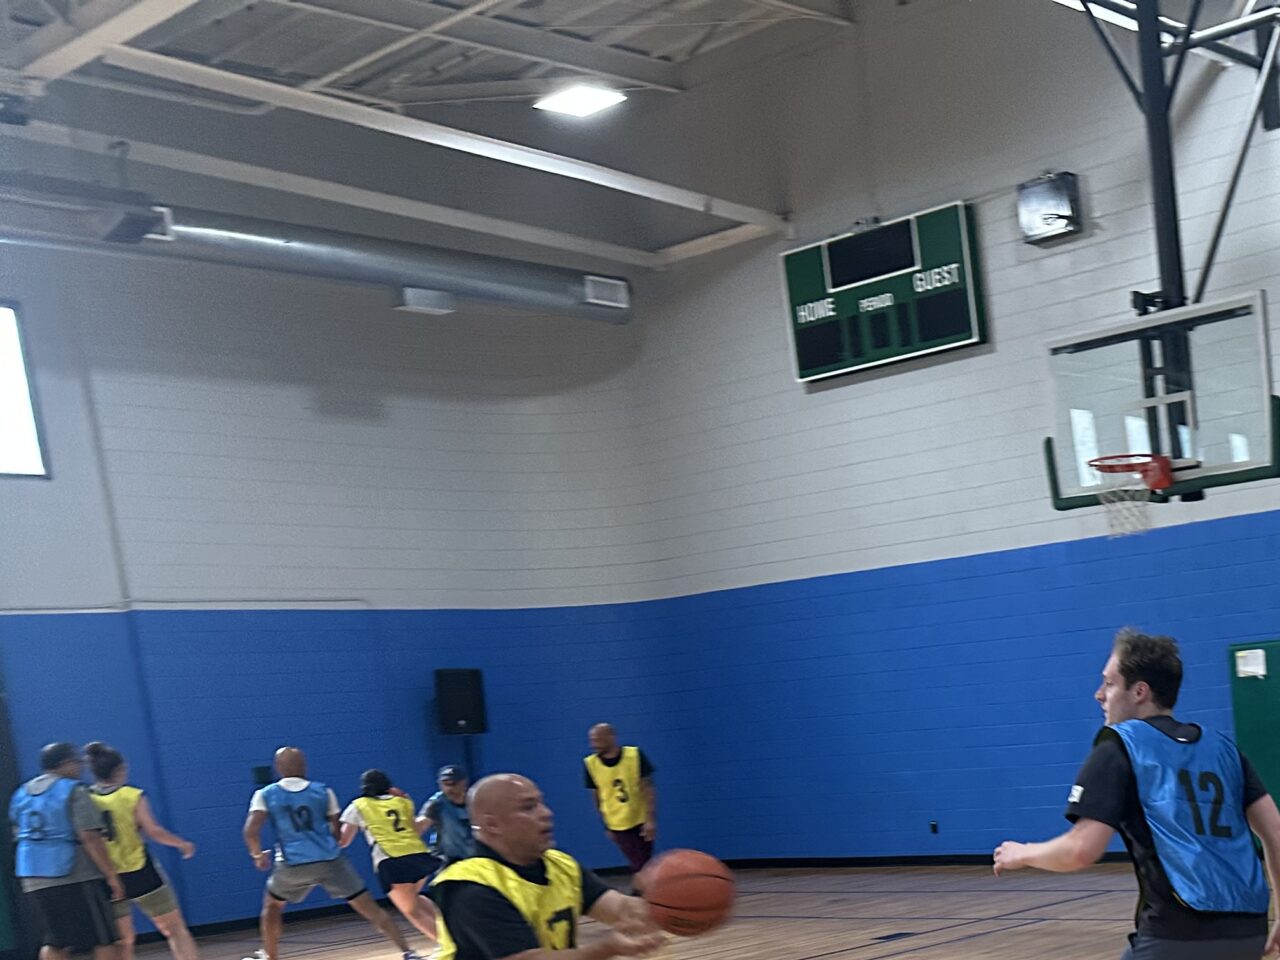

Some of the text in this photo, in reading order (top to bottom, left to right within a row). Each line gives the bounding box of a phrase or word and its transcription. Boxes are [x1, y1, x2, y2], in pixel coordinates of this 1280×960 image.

[913, 263, 960, 292] GUEST
[796, 298, 837, 323] HOME
[612, 778, 629, 803] 3
[1178, 768, 1232, 838] 12
[386, 809, 405, 832] 2
